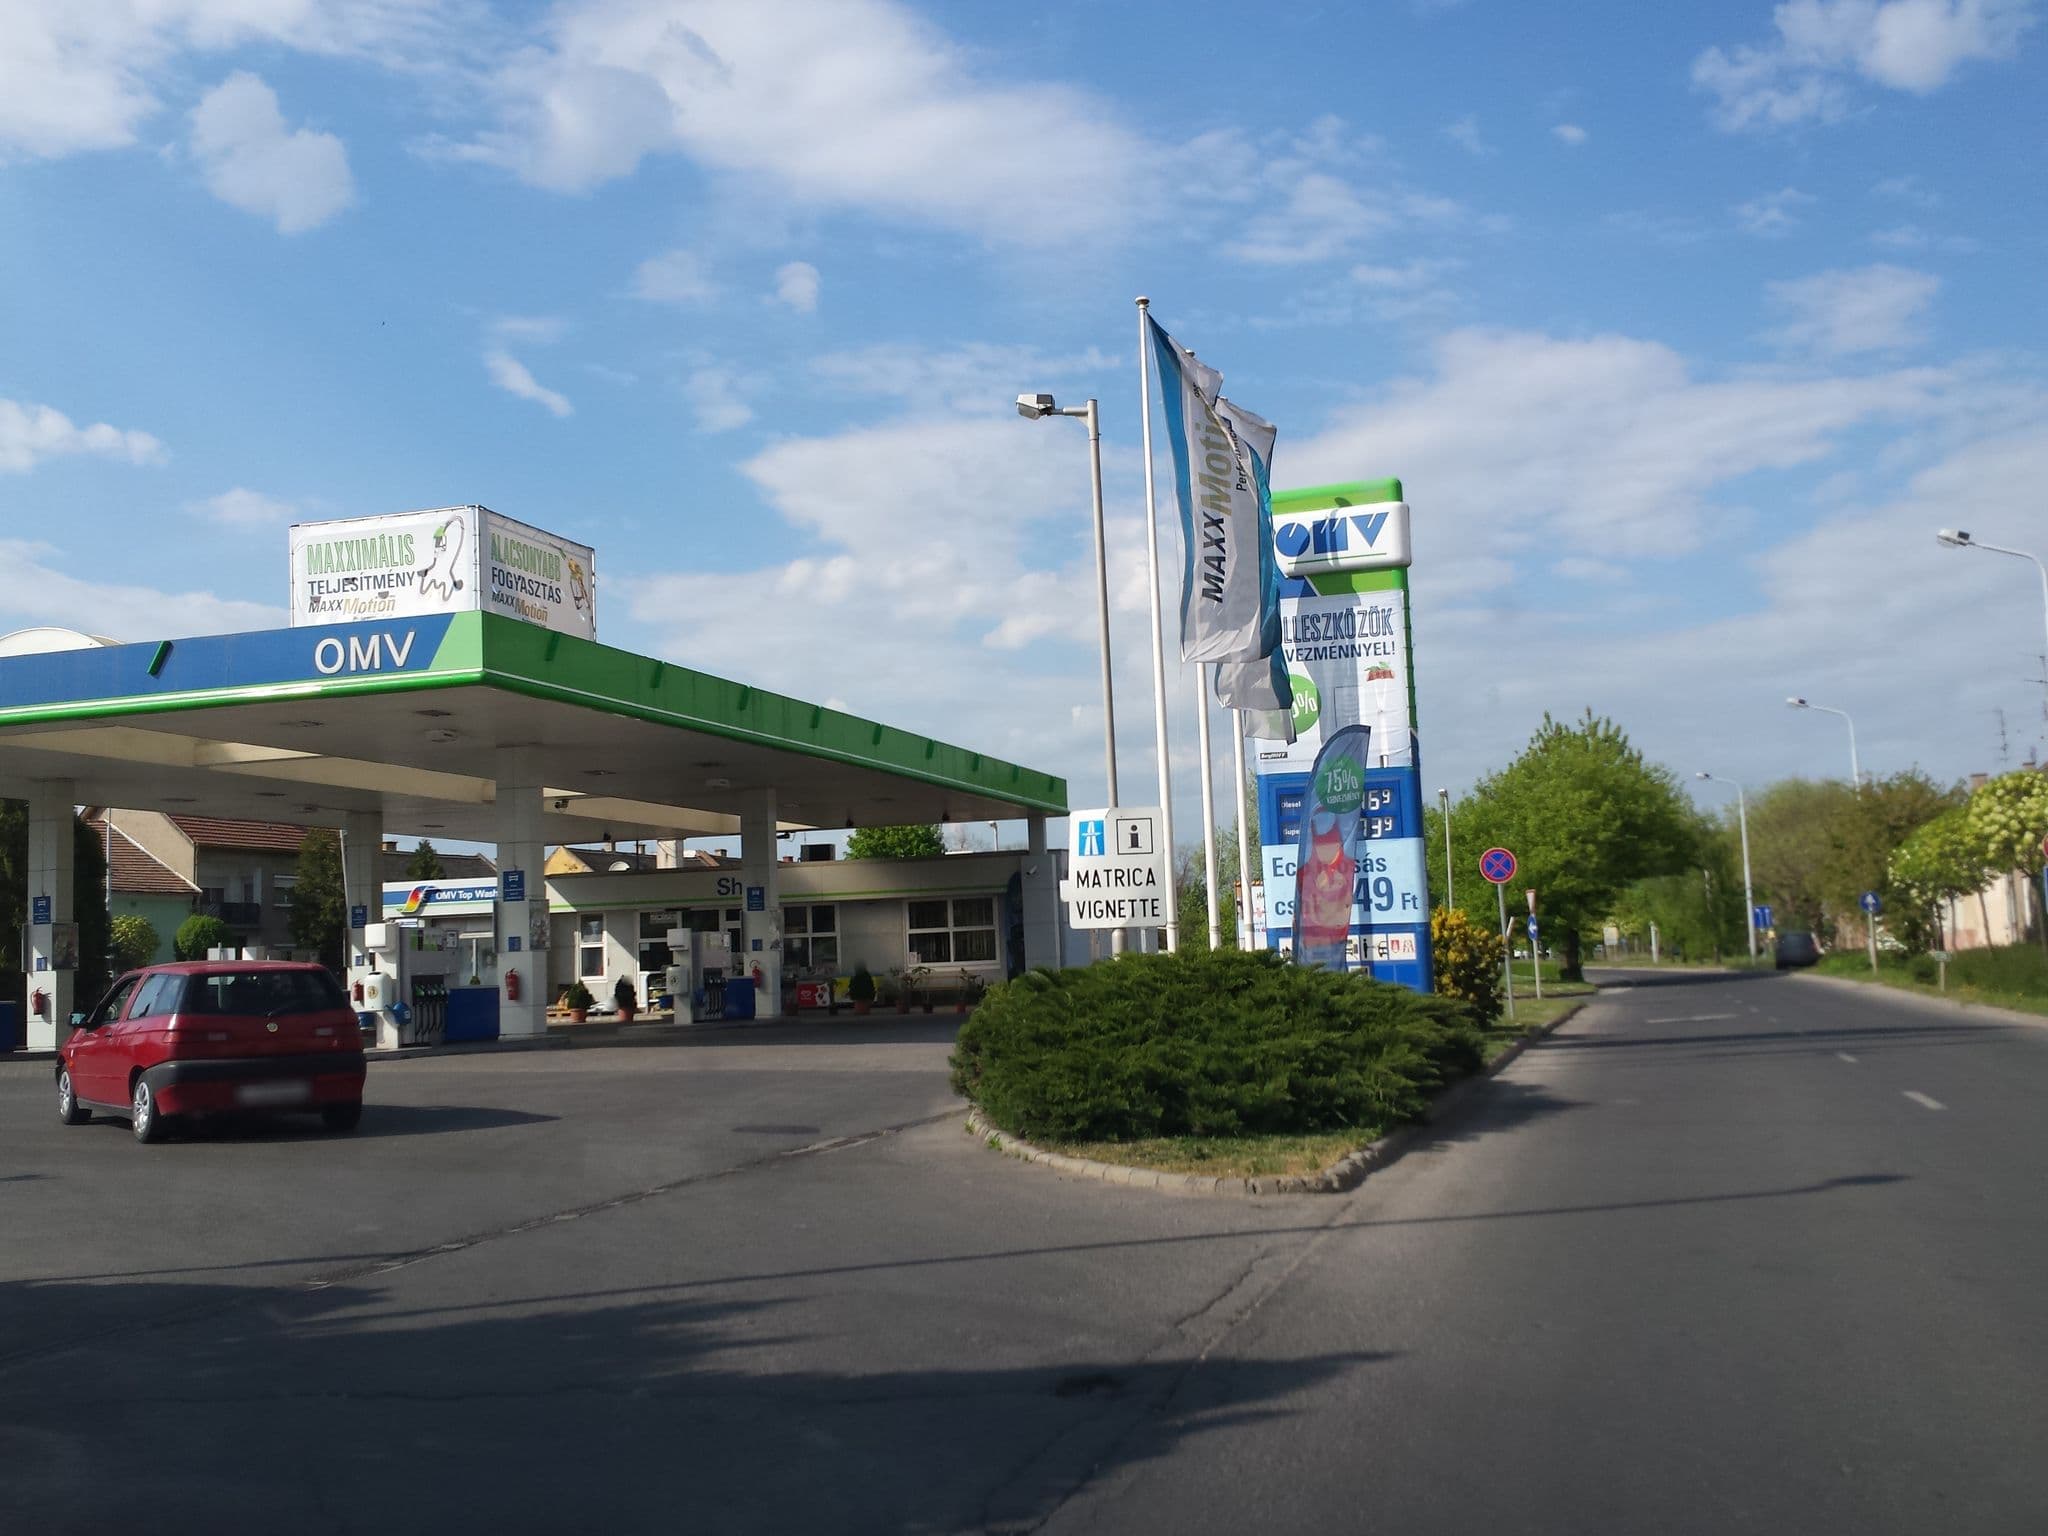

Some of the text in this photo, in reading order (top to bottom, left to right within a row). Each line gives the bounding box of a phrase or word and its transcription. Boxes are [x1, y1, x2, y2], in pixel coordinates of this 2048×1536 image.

[1276, 512, 1389, 557] OMV
[307, 533, 415, 575] MAXXIMÁLIS
[491, 533, 561, 582] ALACSONYABB
[308, 569, 415, 595] TELJESÍTMÉNY
[492, 567, 561, 604] FOGYASZTÁS
[1283, 606, 1394, 643] LLESZKÖZÖK
[315, 631, 415, 674] OMV
[1285, 641, 1395, 663] VEZMÉNNYEL!
[1325, 768, 1359, 793] 75%
[1284, 829, 1300, 837] Supe
[717, 877, 742, 896] Sh
[1076, 867, 1156, 888] MATRICA
[436, 890, 458, 900] OMV
[459, 890, 472, 900] Top
[475, 888, 498, 898] Wash
[1401, 892, 1418, 911] Ft
[1076, 898, 1160, 919] VIGNETTE
